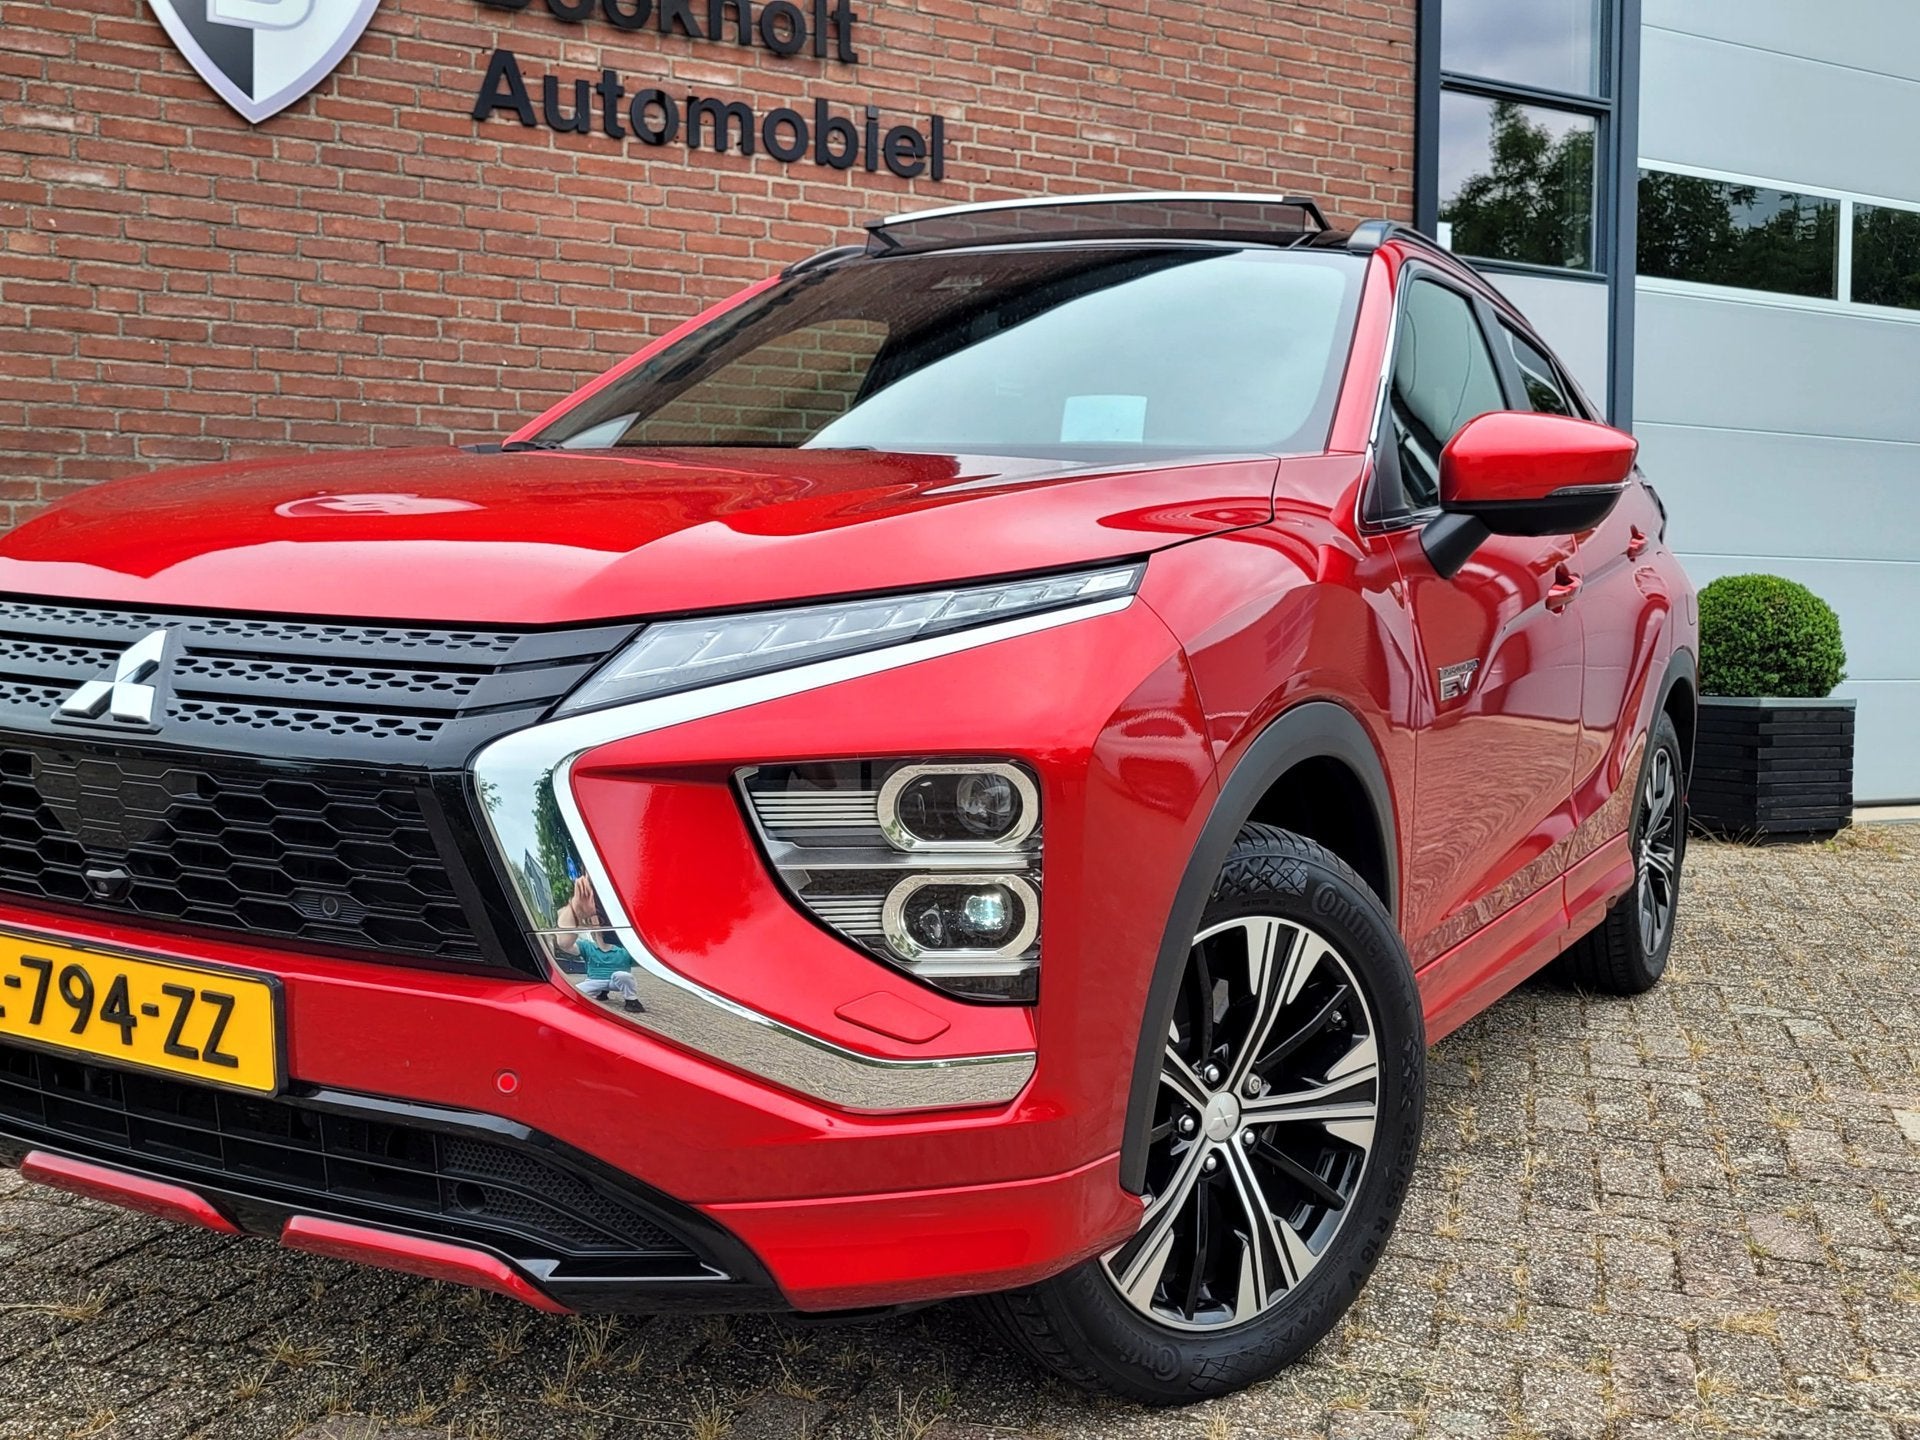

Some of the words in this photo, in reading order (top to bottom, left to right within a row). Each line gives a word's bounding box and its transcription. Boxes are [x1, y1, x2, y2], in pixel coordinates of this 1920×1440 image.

[475, 0, 858, 64] okholt
[473, 49, 943, 182] Automobiel
[0, 954, 239, 1068] -794-ZZ
